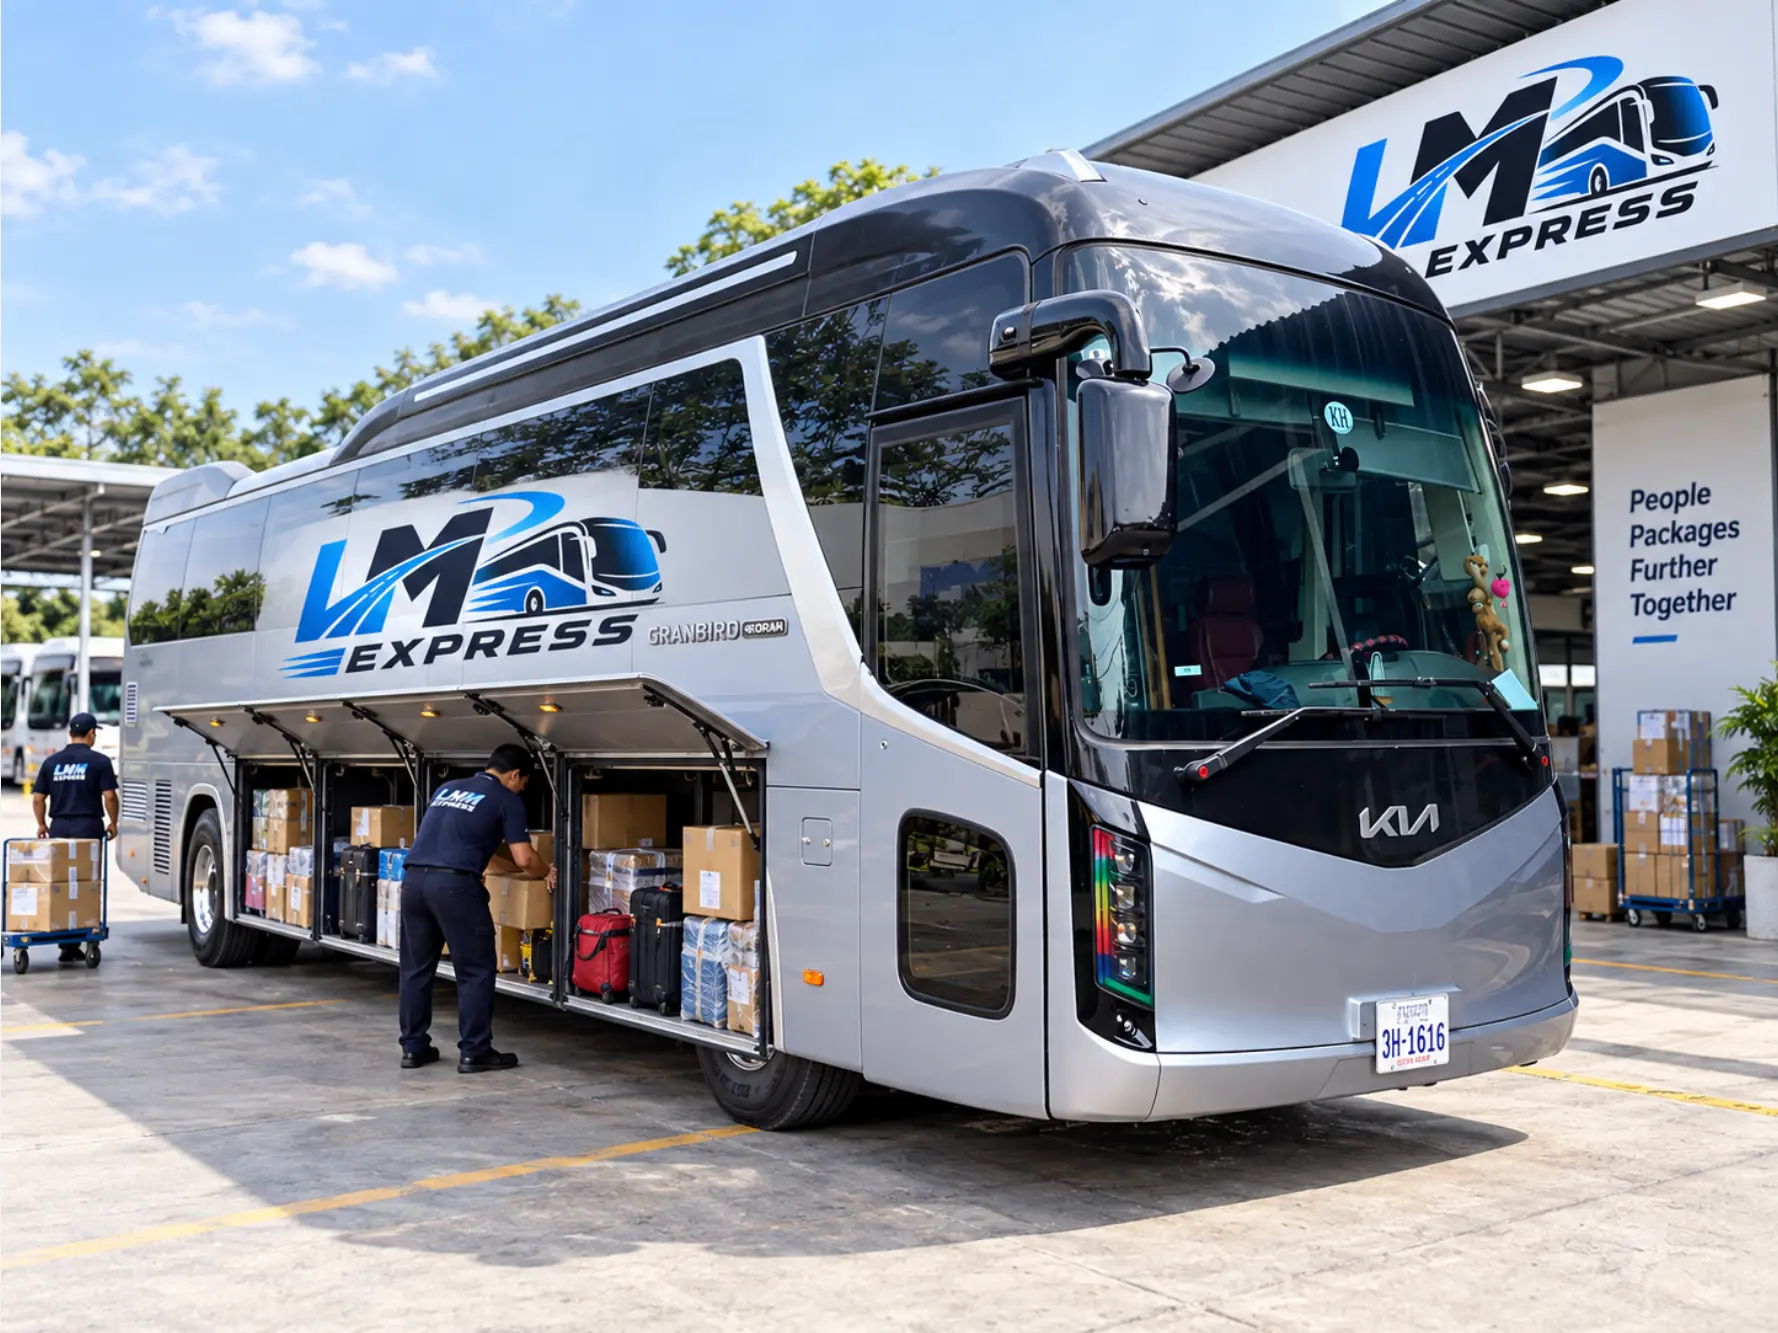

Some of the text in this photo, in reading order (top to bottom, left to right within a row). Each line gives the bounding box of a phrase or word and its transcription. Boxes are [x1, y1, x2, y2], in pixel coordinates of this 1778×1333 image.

[1425, 180, 1699, 279] EXPRESS
[1629, 481, 1711, 514] People
[1630, 520, 1740, 548] Packages
[1630, 554, 1718, 582] Further
[1630, 588, 1737, 621] Together
[344, 613, 638, 673] EXPRESS
[648, 620, 740, 646] GRANBIRD
[1359, 803, 1440, 839] KIA
[1382, 1022, 1445, 1059] 3H-1616
